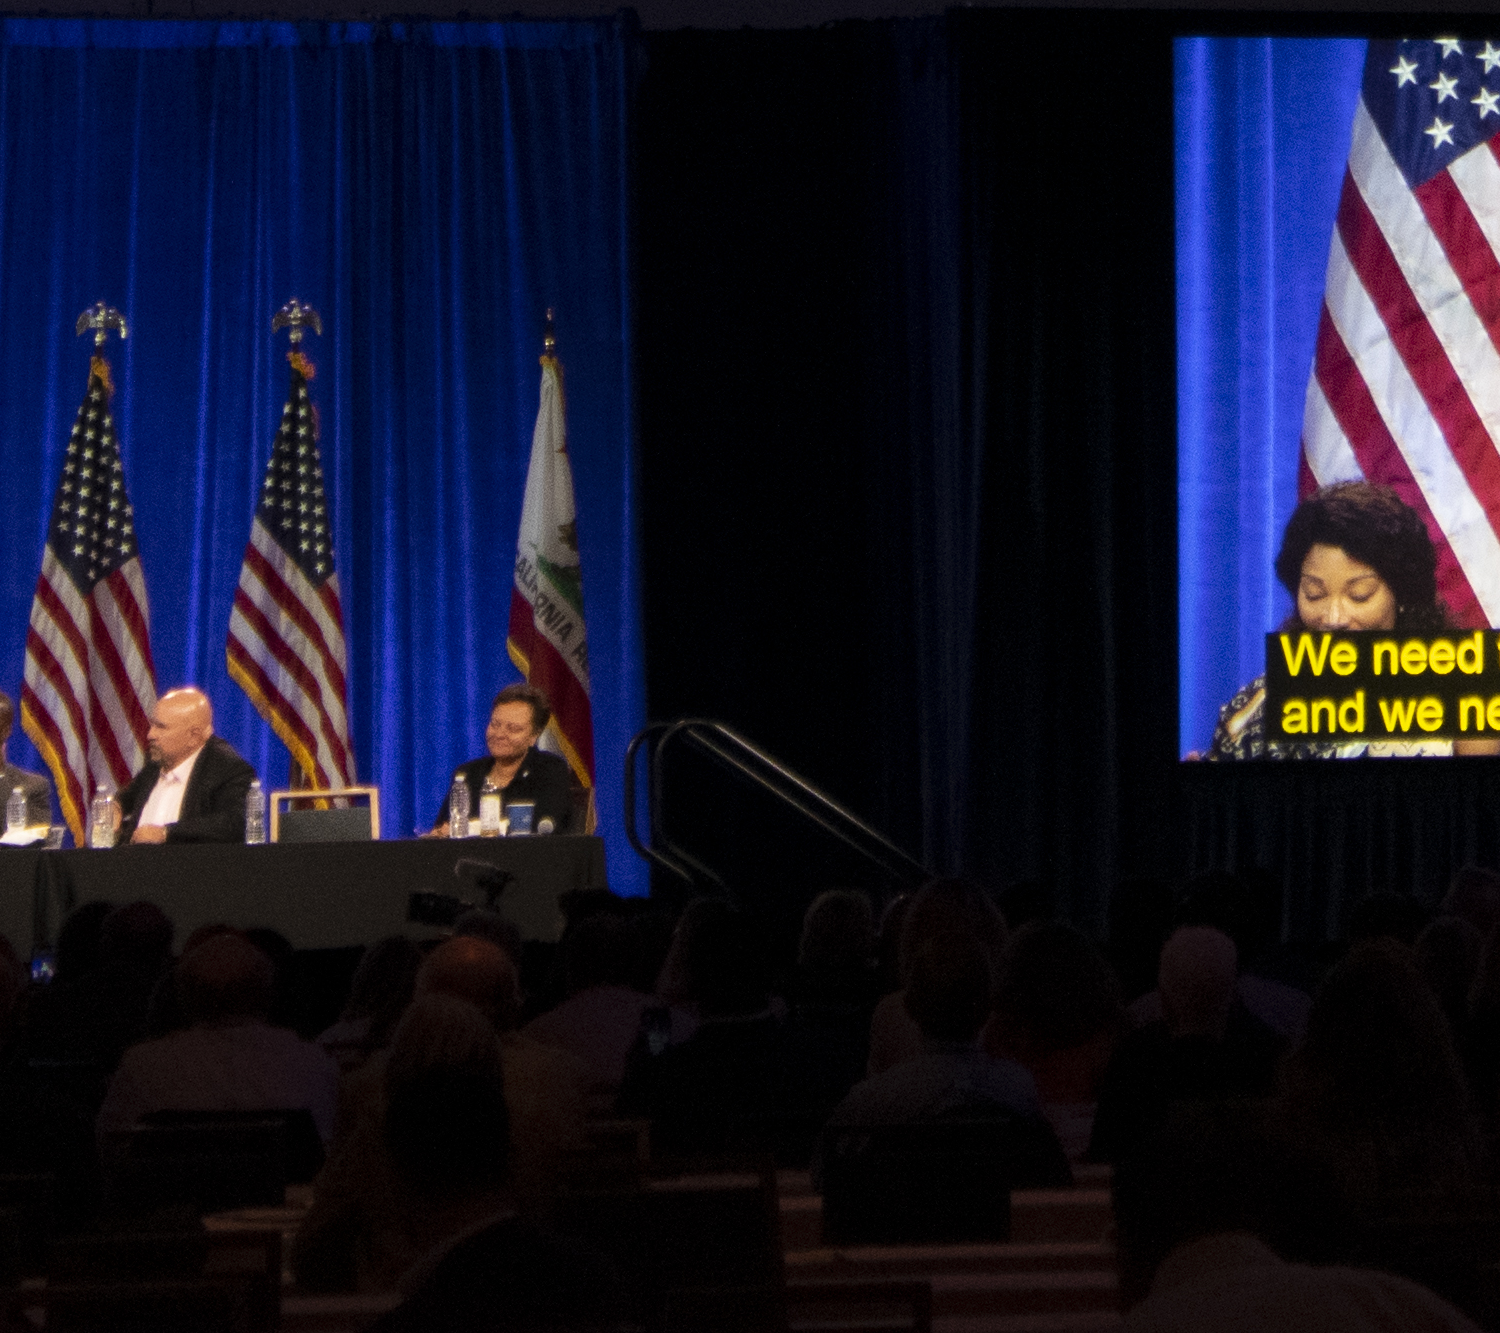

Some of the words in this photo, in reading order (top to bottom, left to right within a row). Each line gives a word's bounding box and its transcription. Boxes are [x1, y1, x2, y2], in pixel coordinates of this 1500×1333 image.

[1281, 632, 1359, 677] We
[1373, 631, 1486, 676] need
[1283, 690, 1367, 735] and
[1379, 698, 1446, 733] we
